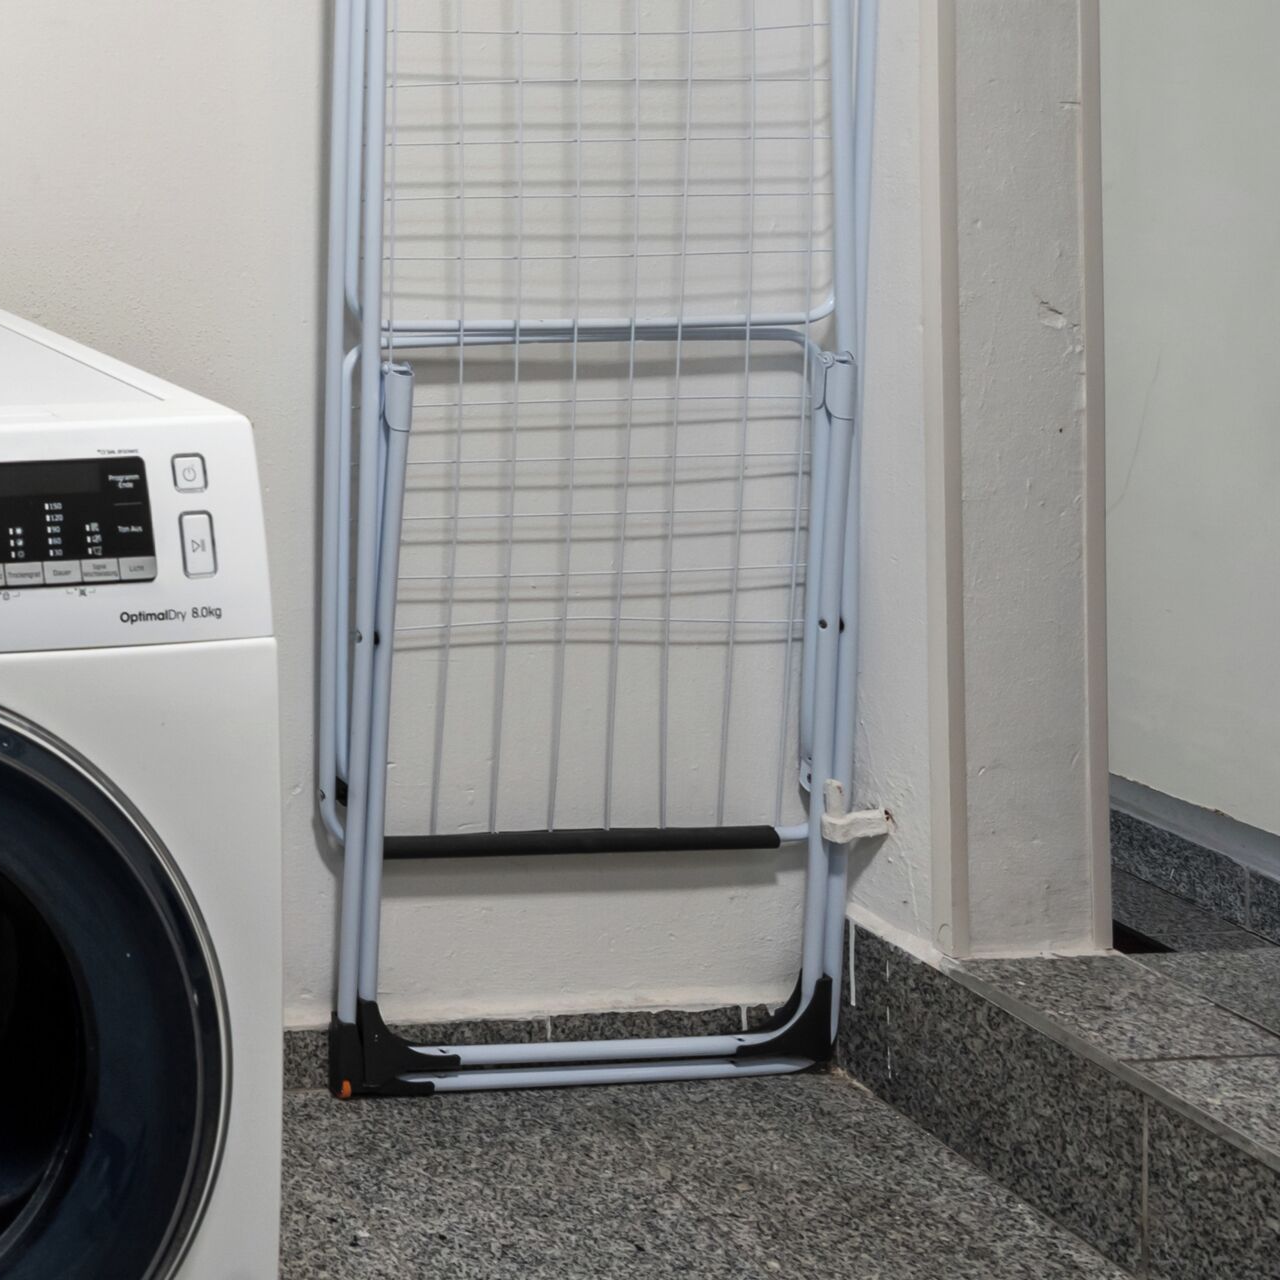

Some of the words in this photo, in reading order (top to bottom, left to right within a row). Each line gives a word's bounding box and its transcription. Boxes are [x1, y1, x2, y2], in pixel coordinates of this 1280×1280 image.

[51, 514, 63, 522] 120
[120, 609, 187, 624] OptimalDry
[192, 606, 222, 619] 8.0kg
